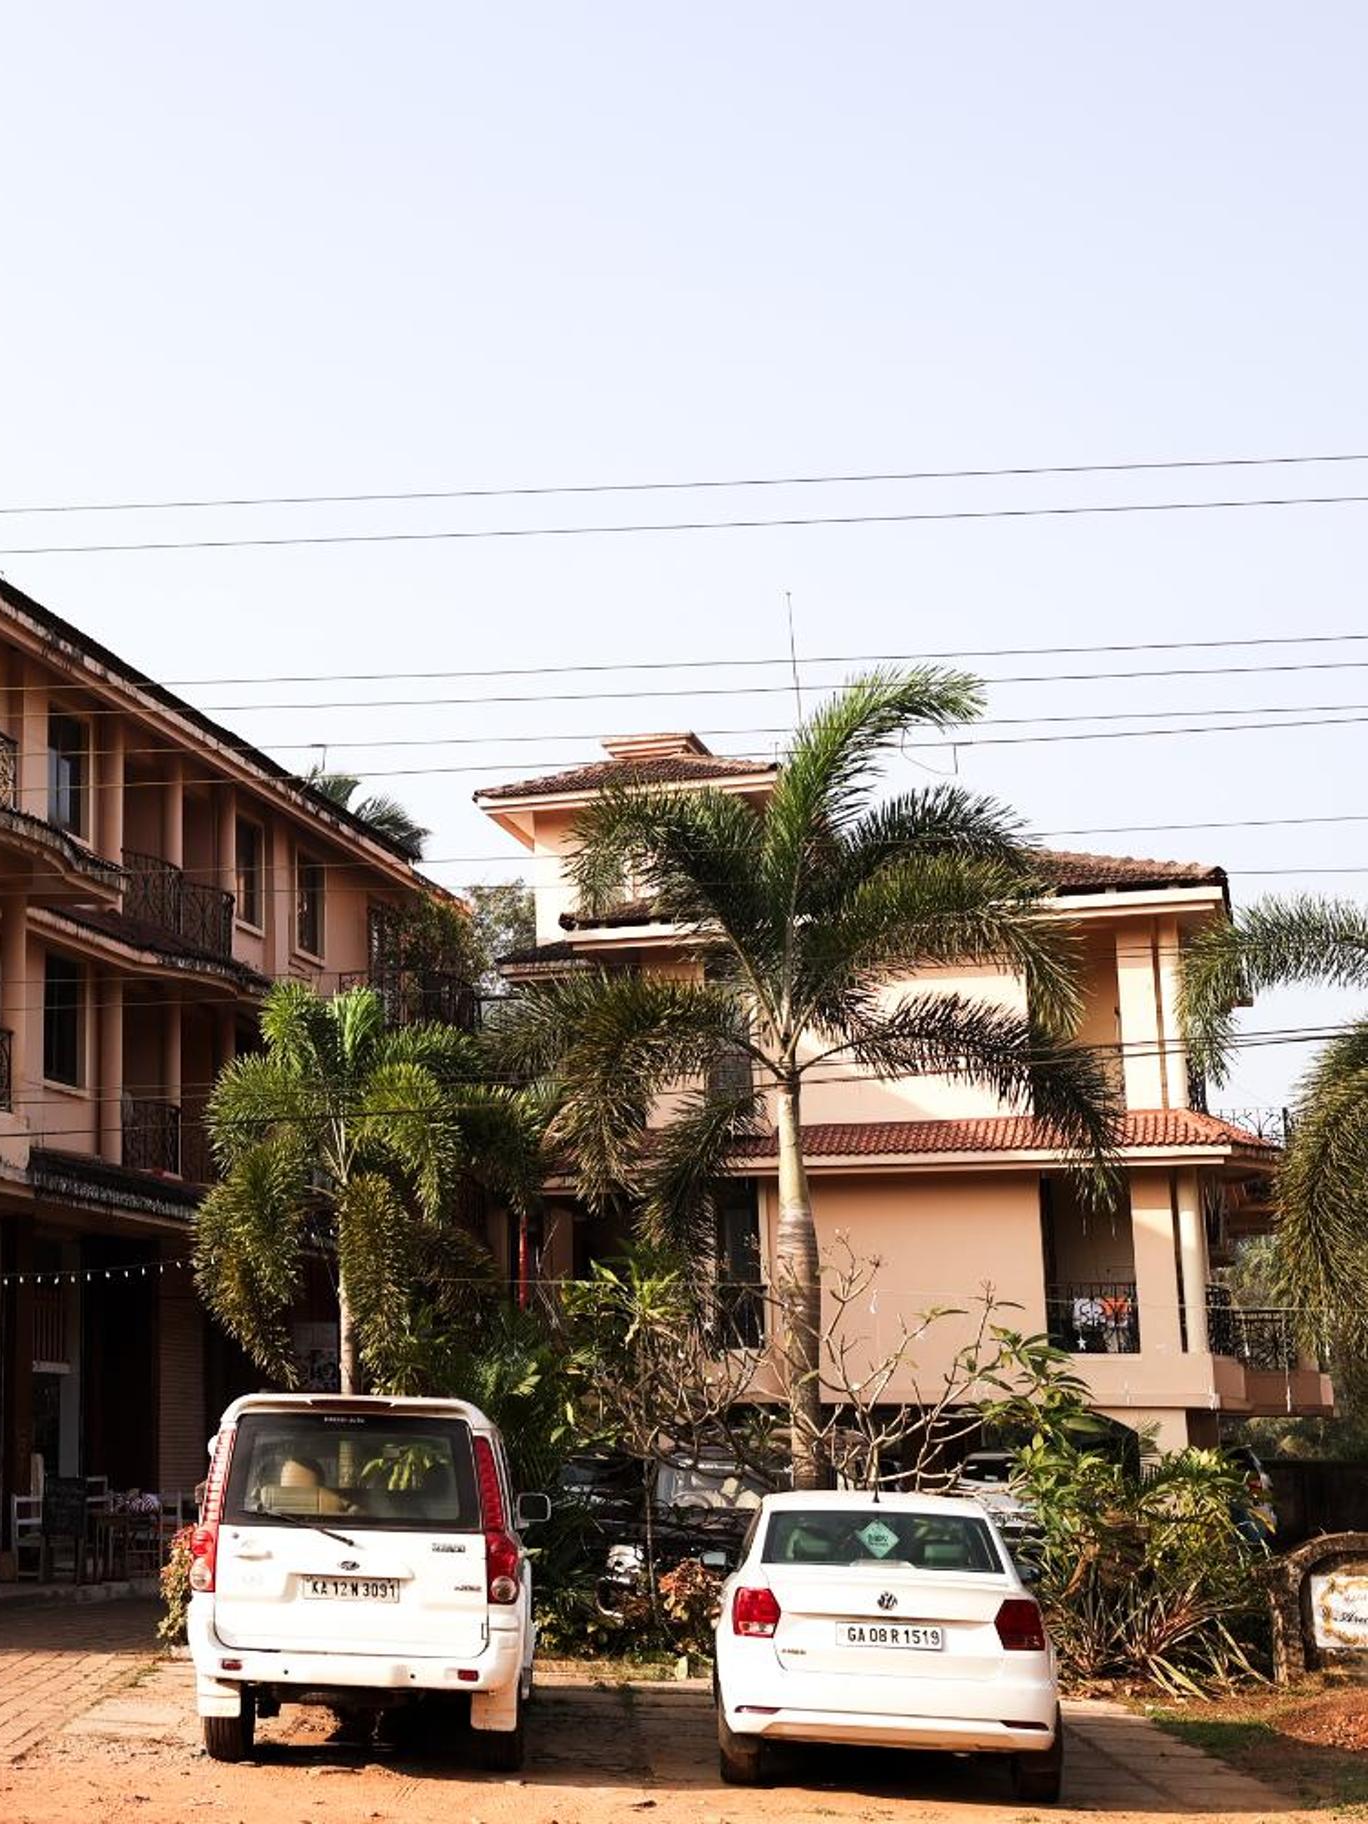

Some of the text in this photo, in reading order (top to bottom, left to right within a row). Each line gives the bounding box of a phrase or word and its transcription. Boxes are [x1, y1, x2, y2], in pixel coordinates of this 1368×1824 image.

[312, 1581, 395, 1598] KA 12 N 3091
[847, 1627, 940, 1645] GA 08 R 1519
